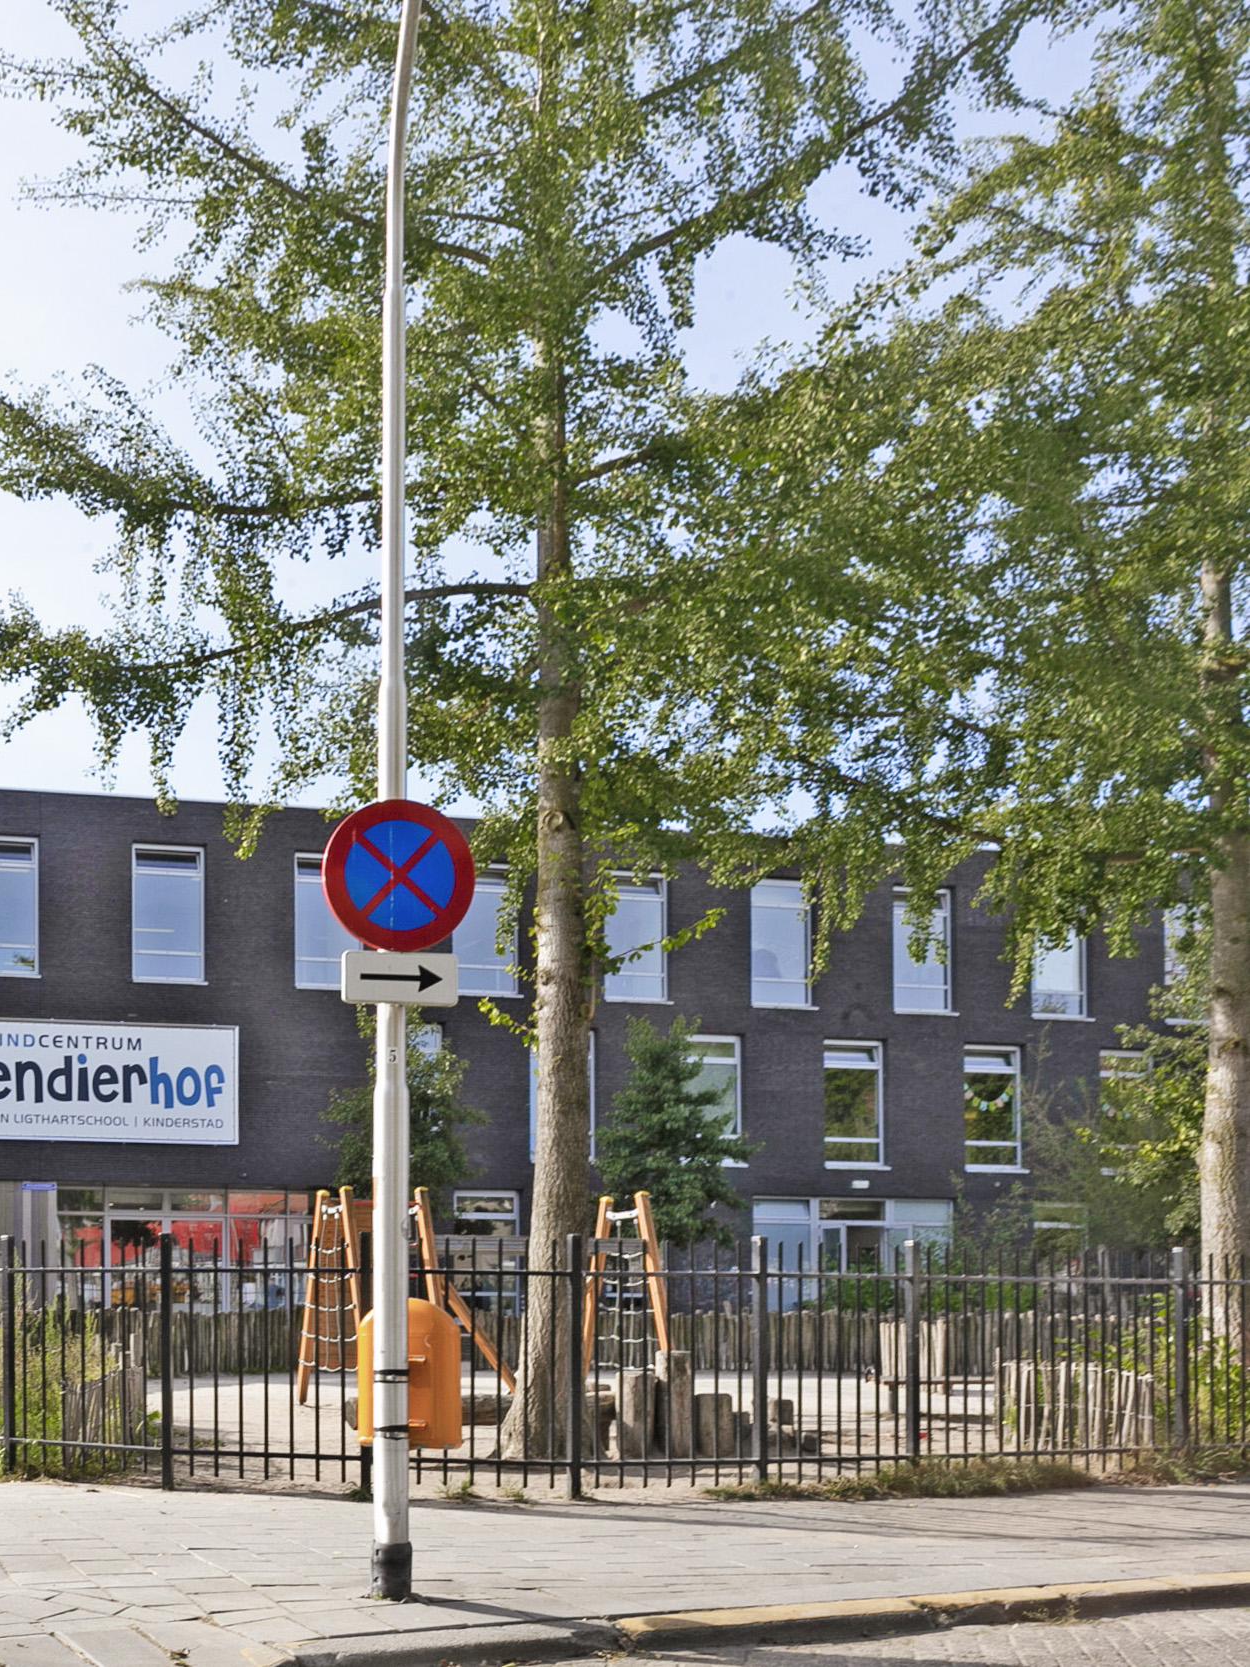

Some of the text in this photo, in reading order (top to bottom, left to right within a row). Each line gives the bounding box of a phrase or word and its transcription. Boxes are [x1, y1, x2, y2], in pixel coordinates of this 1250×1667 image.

[389, 1049, 397, 1063] 5
[14, 1113, 129, 1127] LIGTHARTSCHOOL
[143, 1116, 224, 1129] KINDERSTAD
